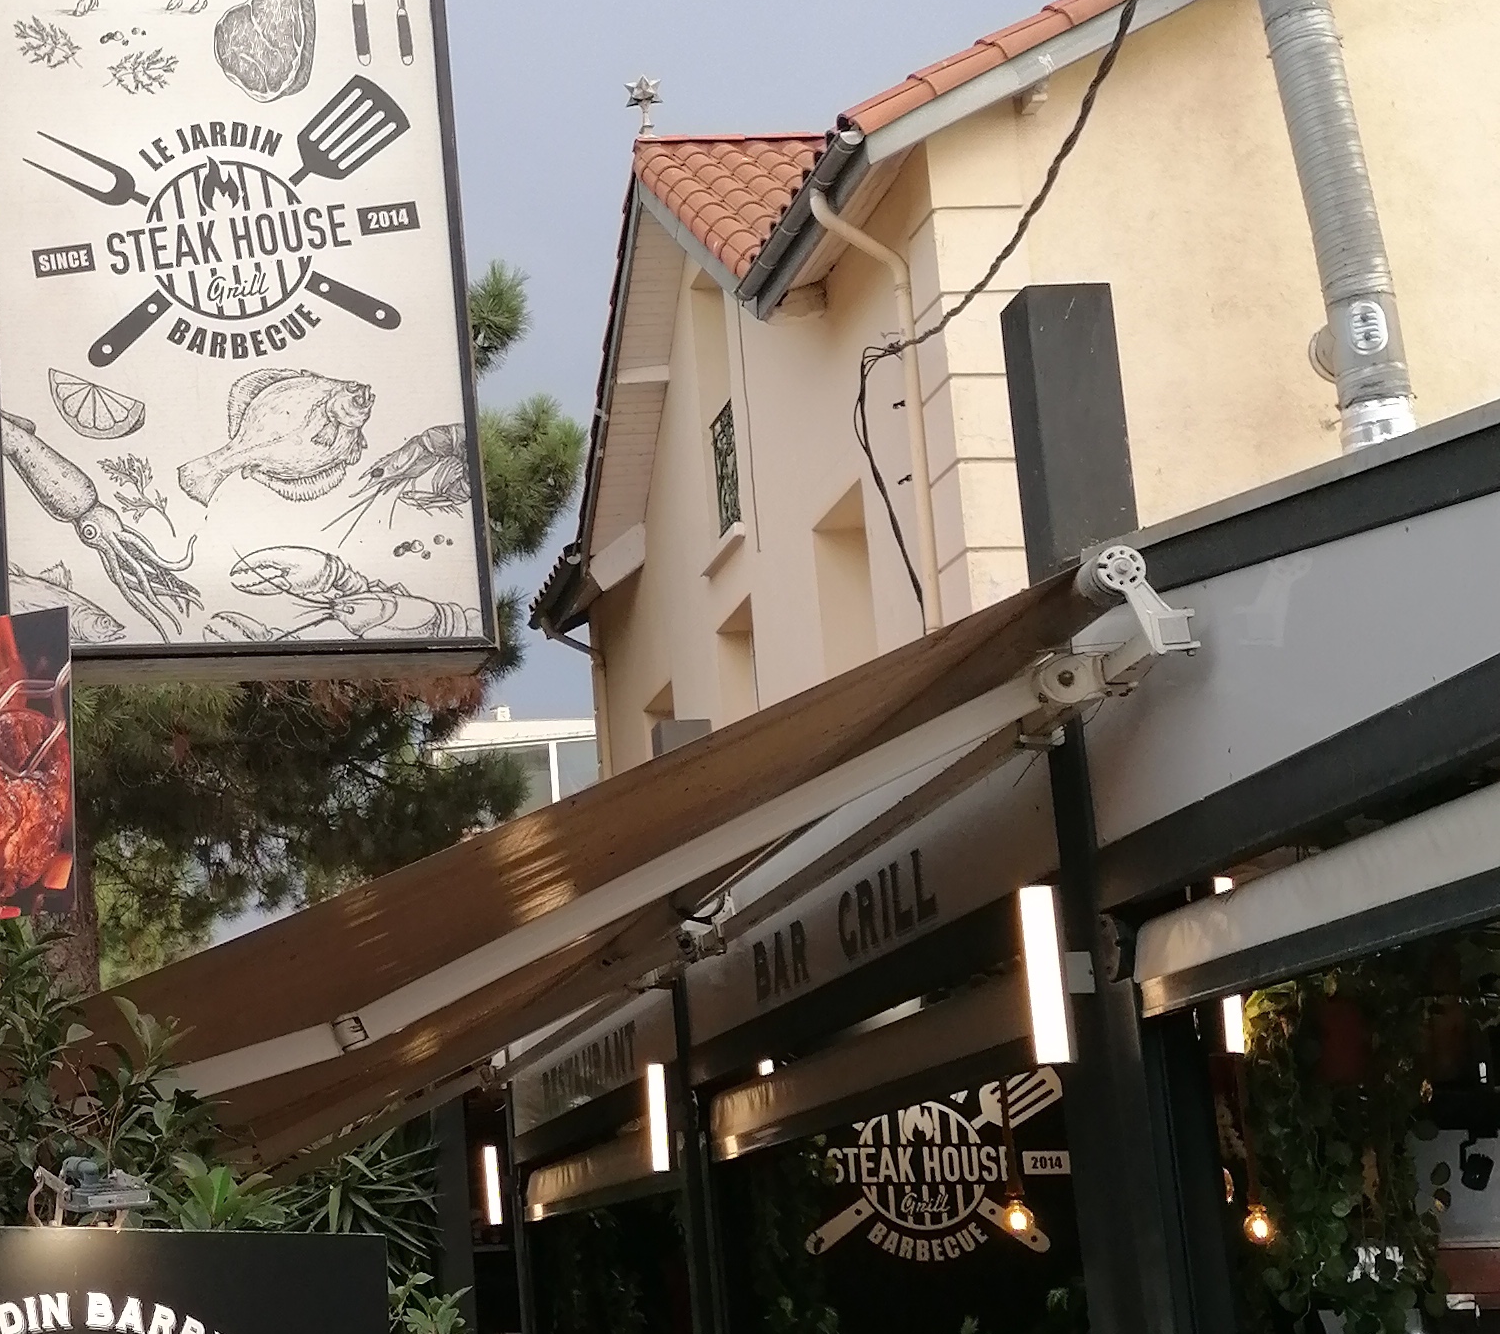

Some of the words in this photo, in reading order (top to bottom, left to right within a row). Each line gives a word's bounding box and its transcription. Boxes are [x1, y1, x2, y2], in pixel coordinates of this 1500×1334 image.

[139, 137, 175, 171] LE
[175, 121, 283, 157] JARDIN
[367, 207, 410, 230] 2014
[106, 219, 222, 275] STEAK
[229, 203, 352, 260] HOUSE
[38, 249, 89, 272] SINCE
[206, 270, 270, 304] Grill
[166, 302, 322, 360] BARBECUE
[752, 920, 810, 1003] BAR
[827, 1146, 915, 1184] STEAK
[1031, 1156, 1063, 1170] 2014
[901, 1192, 950, 1215] Grill
[866, 1221, 990, 1262] BARBECUE
